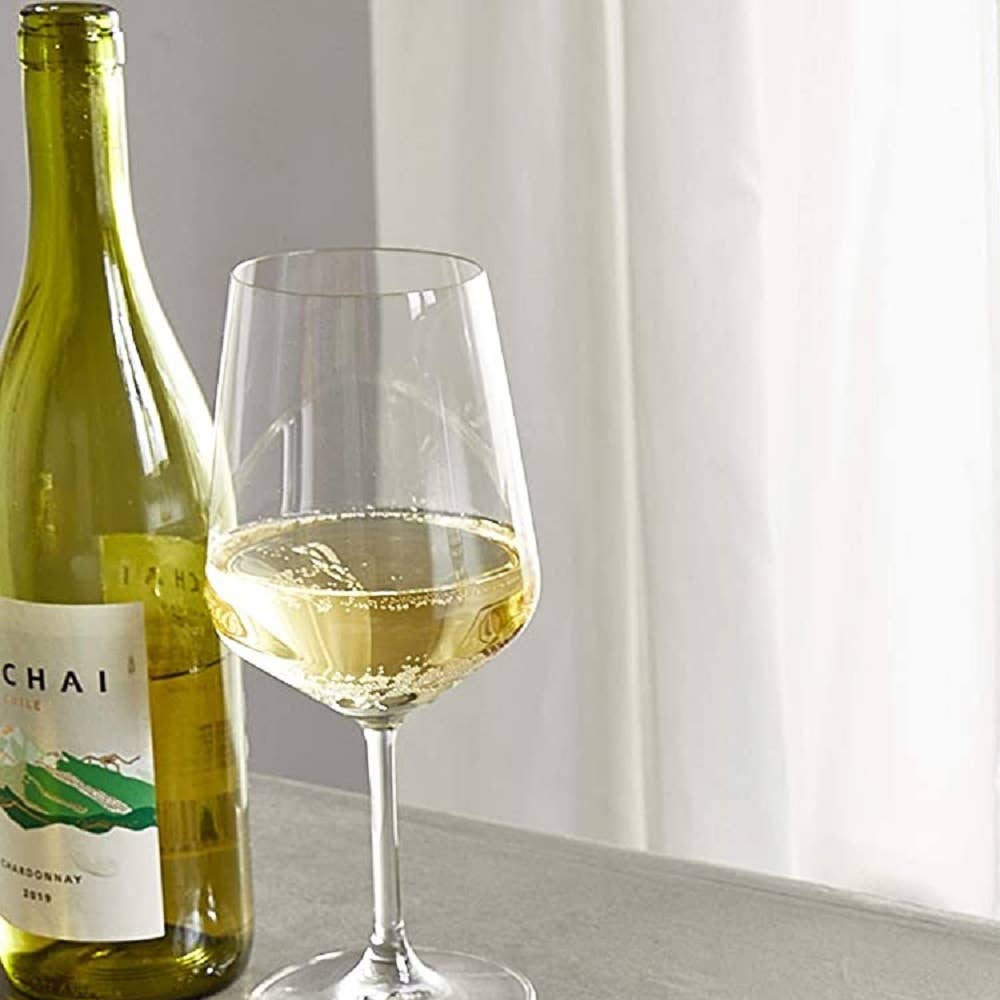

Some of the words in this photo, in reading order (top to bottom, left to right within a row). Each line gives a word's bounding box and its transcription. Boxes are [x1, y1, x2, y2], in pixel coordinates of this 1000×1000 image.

[2, 663, 107, 693] CHAI
[1, 857, 83, 884] CHARDONNAY
[22, 887, 52, 903] 2019
